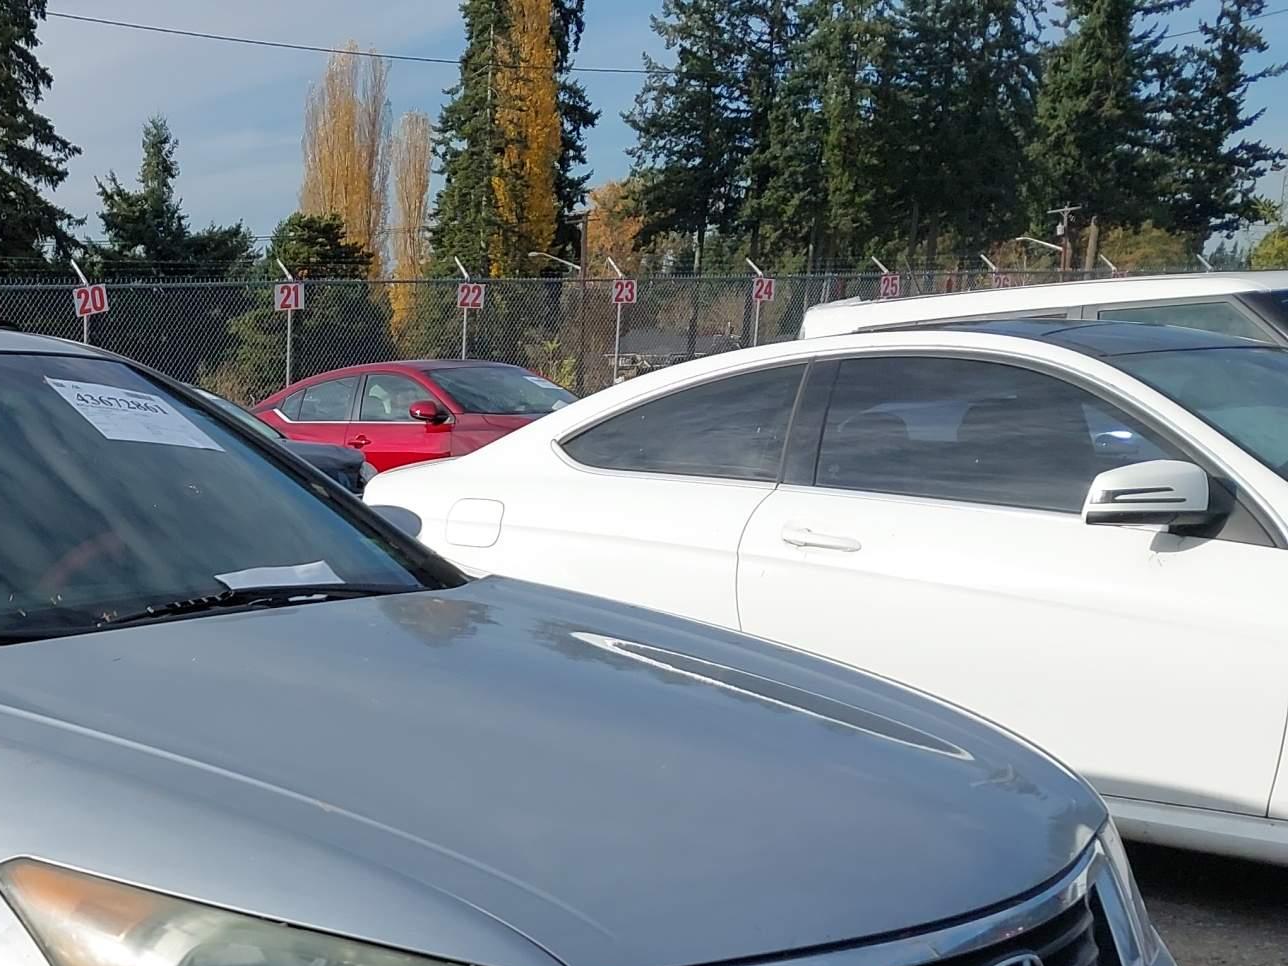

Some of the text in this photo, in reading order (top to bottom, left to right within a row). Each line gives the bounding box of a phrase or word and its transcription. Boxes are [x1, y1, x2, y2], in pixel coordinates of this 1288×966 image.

[280, 285, 300, 309] 21
[459, 285, 482, 307] 22
[614, 281, 634, 303] 23
[755, 279, 773, 300] 24
[882, 276, 899, 297] 25
[76, 285, 104, 315] 20
[76, 392, 169, 415] 43672861
